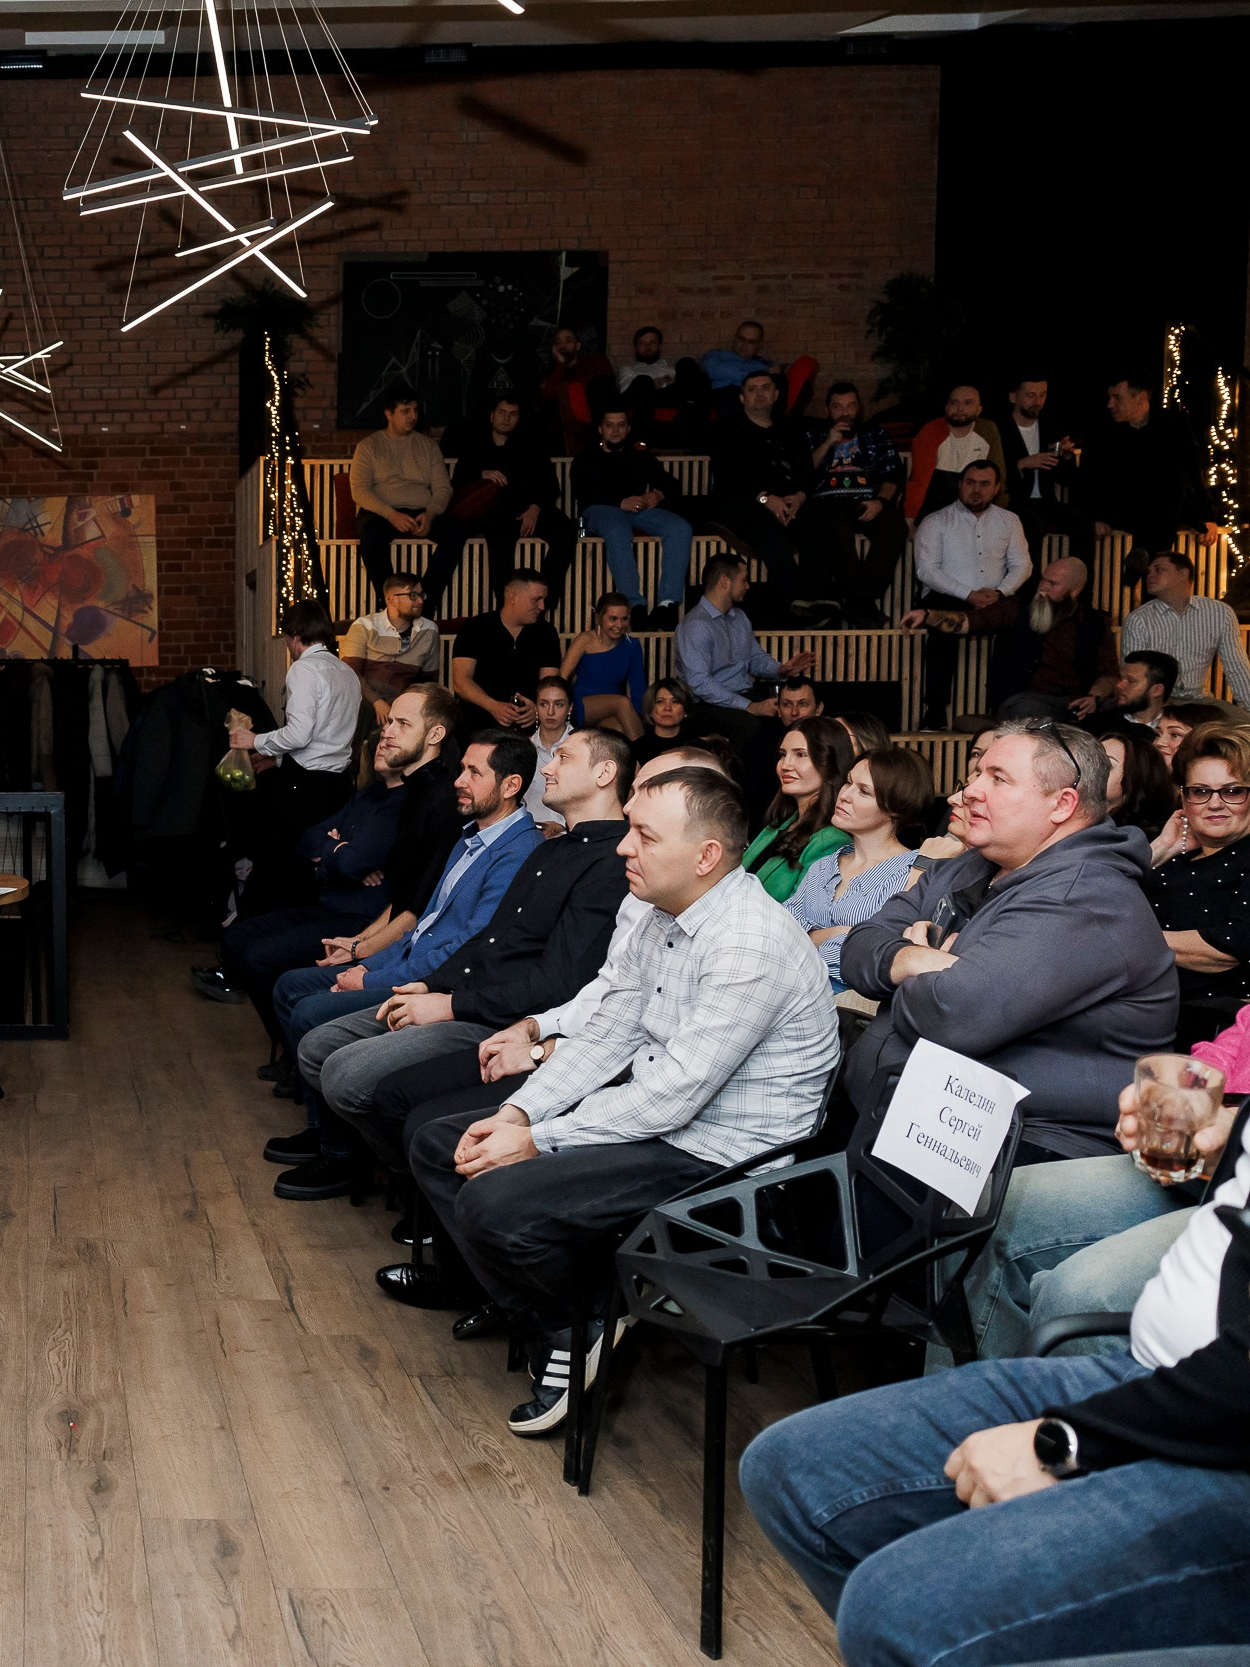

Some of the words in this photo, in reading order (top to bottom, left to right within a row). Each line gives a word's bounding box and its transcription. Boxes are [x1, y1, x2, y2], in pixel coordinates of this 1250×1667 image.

[943, 1075, 997, 1115] Каледин
[939, 1106, 983, 1142] Сергей
[905, 1122, 982, 1178] Геннадьевич
